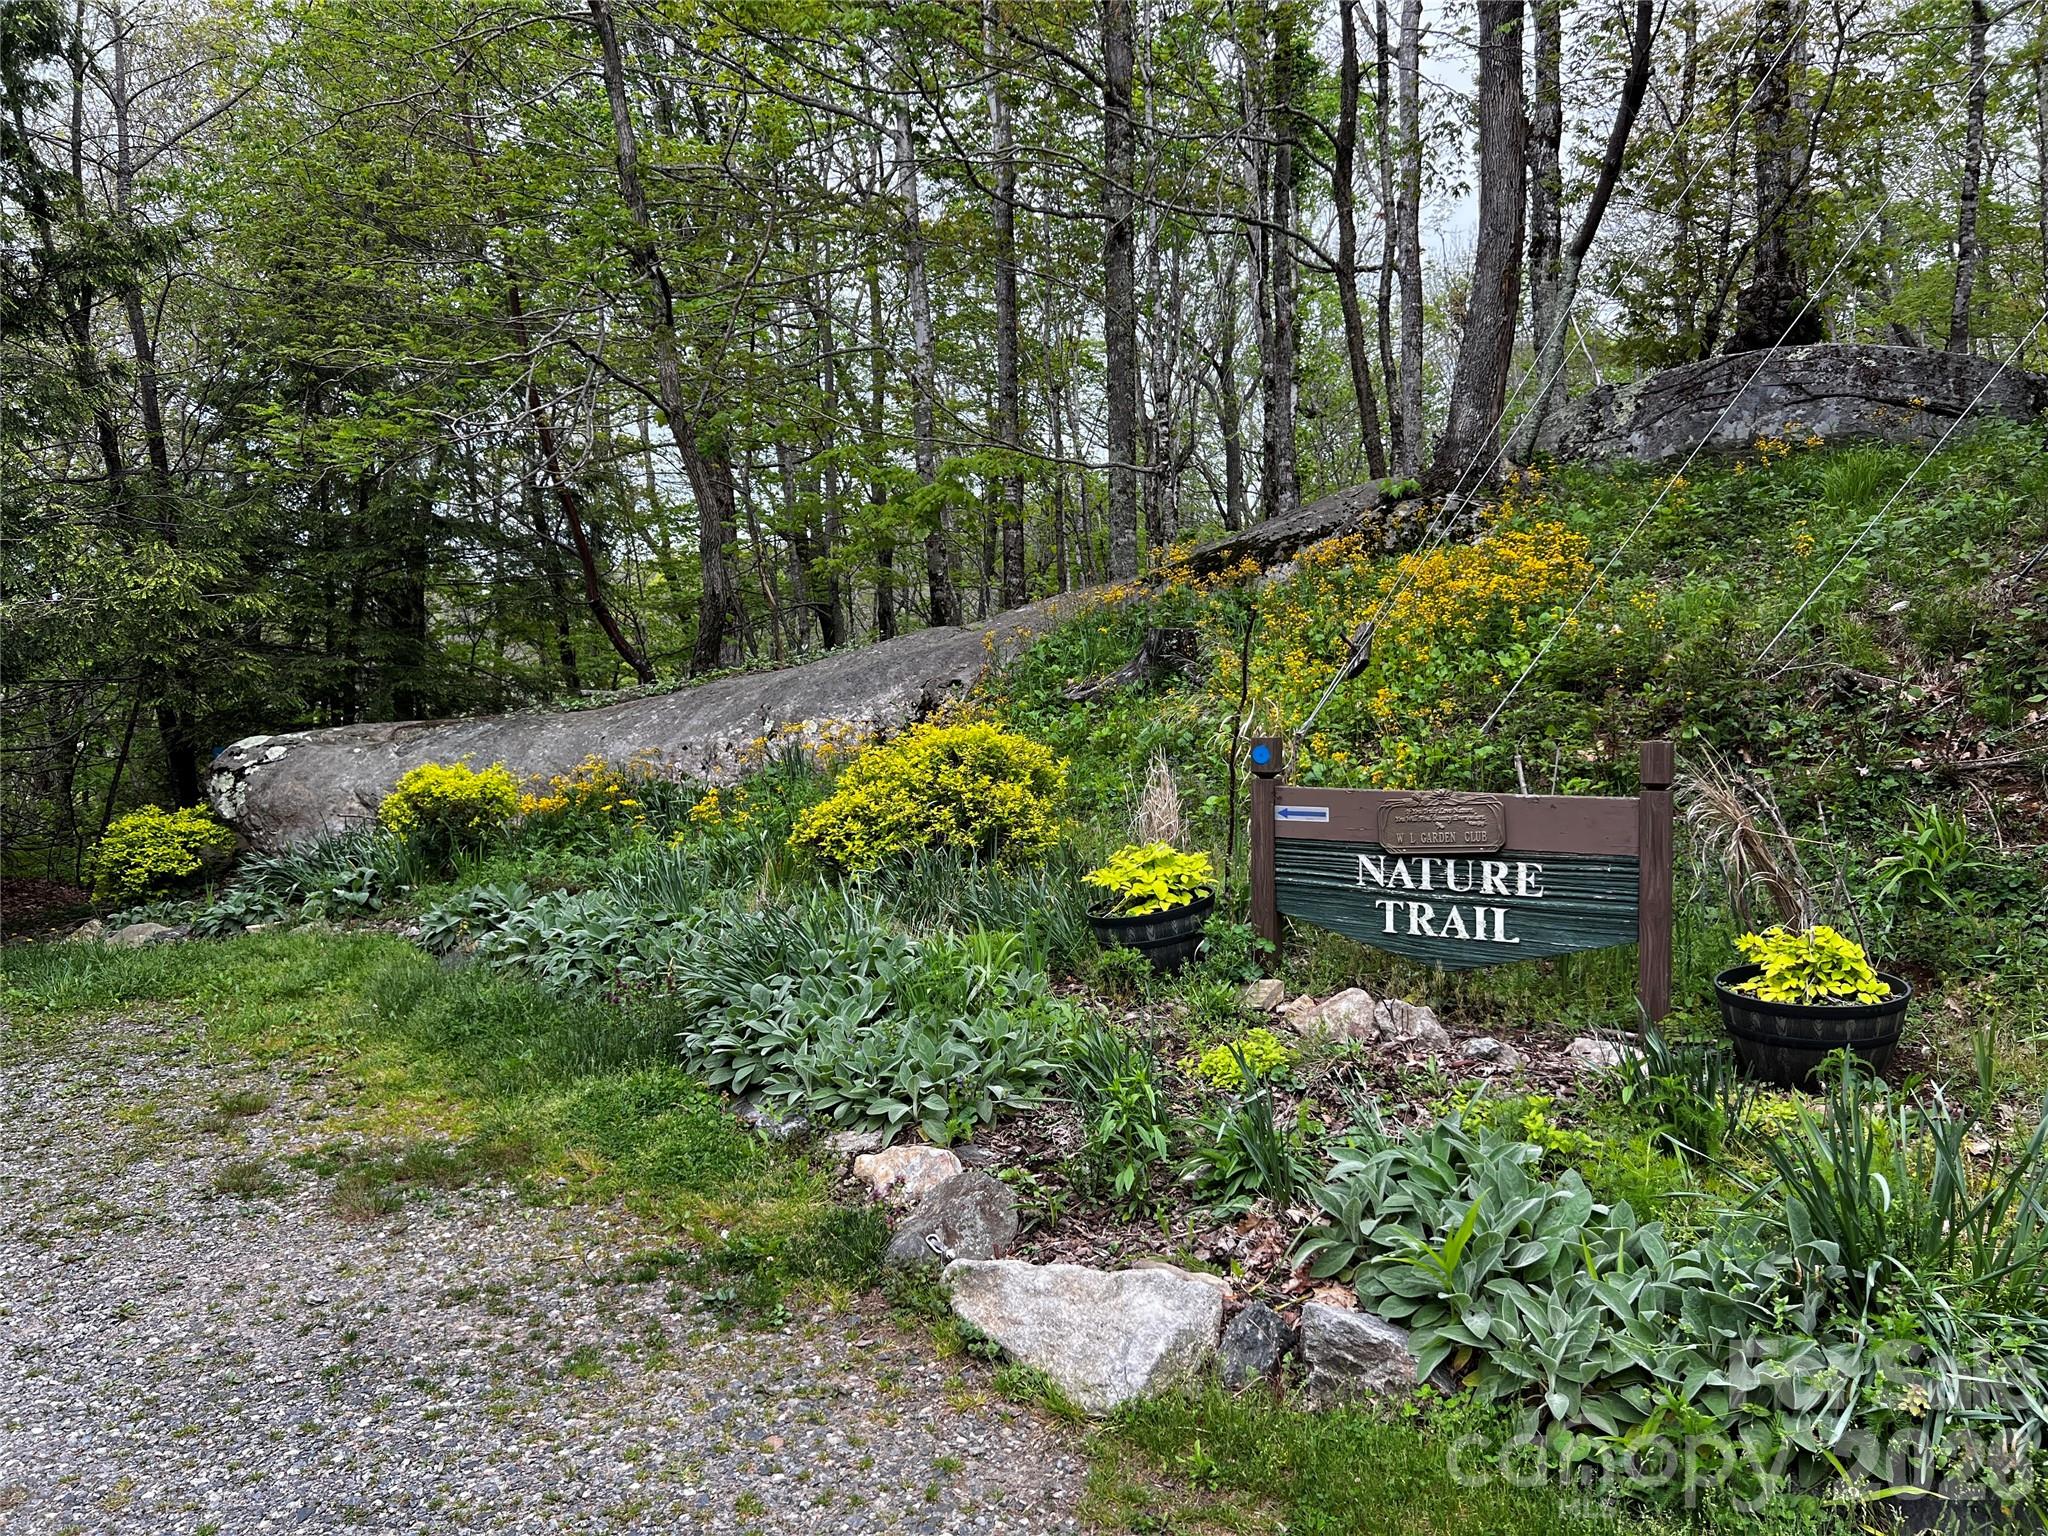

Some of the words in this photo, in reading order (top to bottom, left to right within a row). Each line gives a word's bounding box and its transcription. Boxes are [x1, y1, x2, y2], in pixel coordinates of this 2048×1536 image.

[1396, 832, 1405, 844] W
[1409, 832, 1417, 844] L
[1420, 831, 1457, 843] GARDEN
[1464, 830, 1488, 843] CLUB
[1356, 854, 1544, 898] NATURE
[1375, 899, 1521, 944] TRAIL
